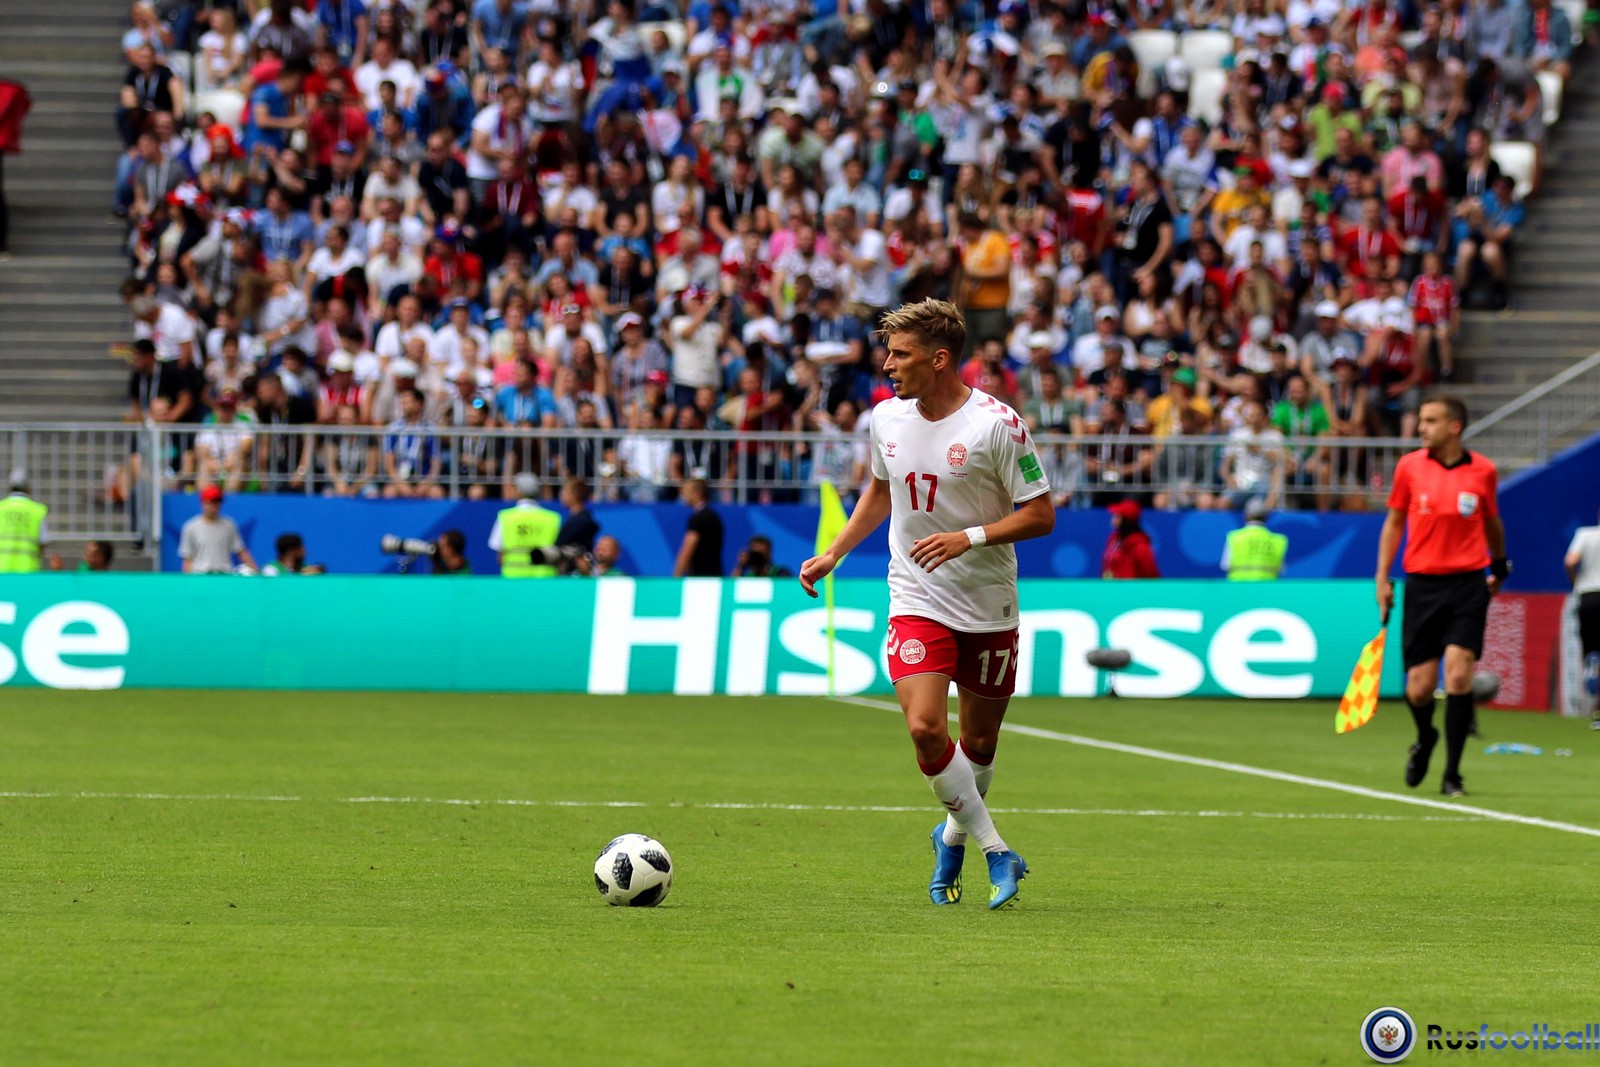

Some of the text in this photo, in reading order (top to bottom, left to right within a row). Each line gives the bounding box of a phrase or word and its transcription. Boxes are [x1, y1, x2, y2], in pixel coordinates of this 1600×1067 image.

[904, 471, 938, 513] 17
[587, 576, 1318, 699] Hisnse
[978, 648, 1011, 686] 17
